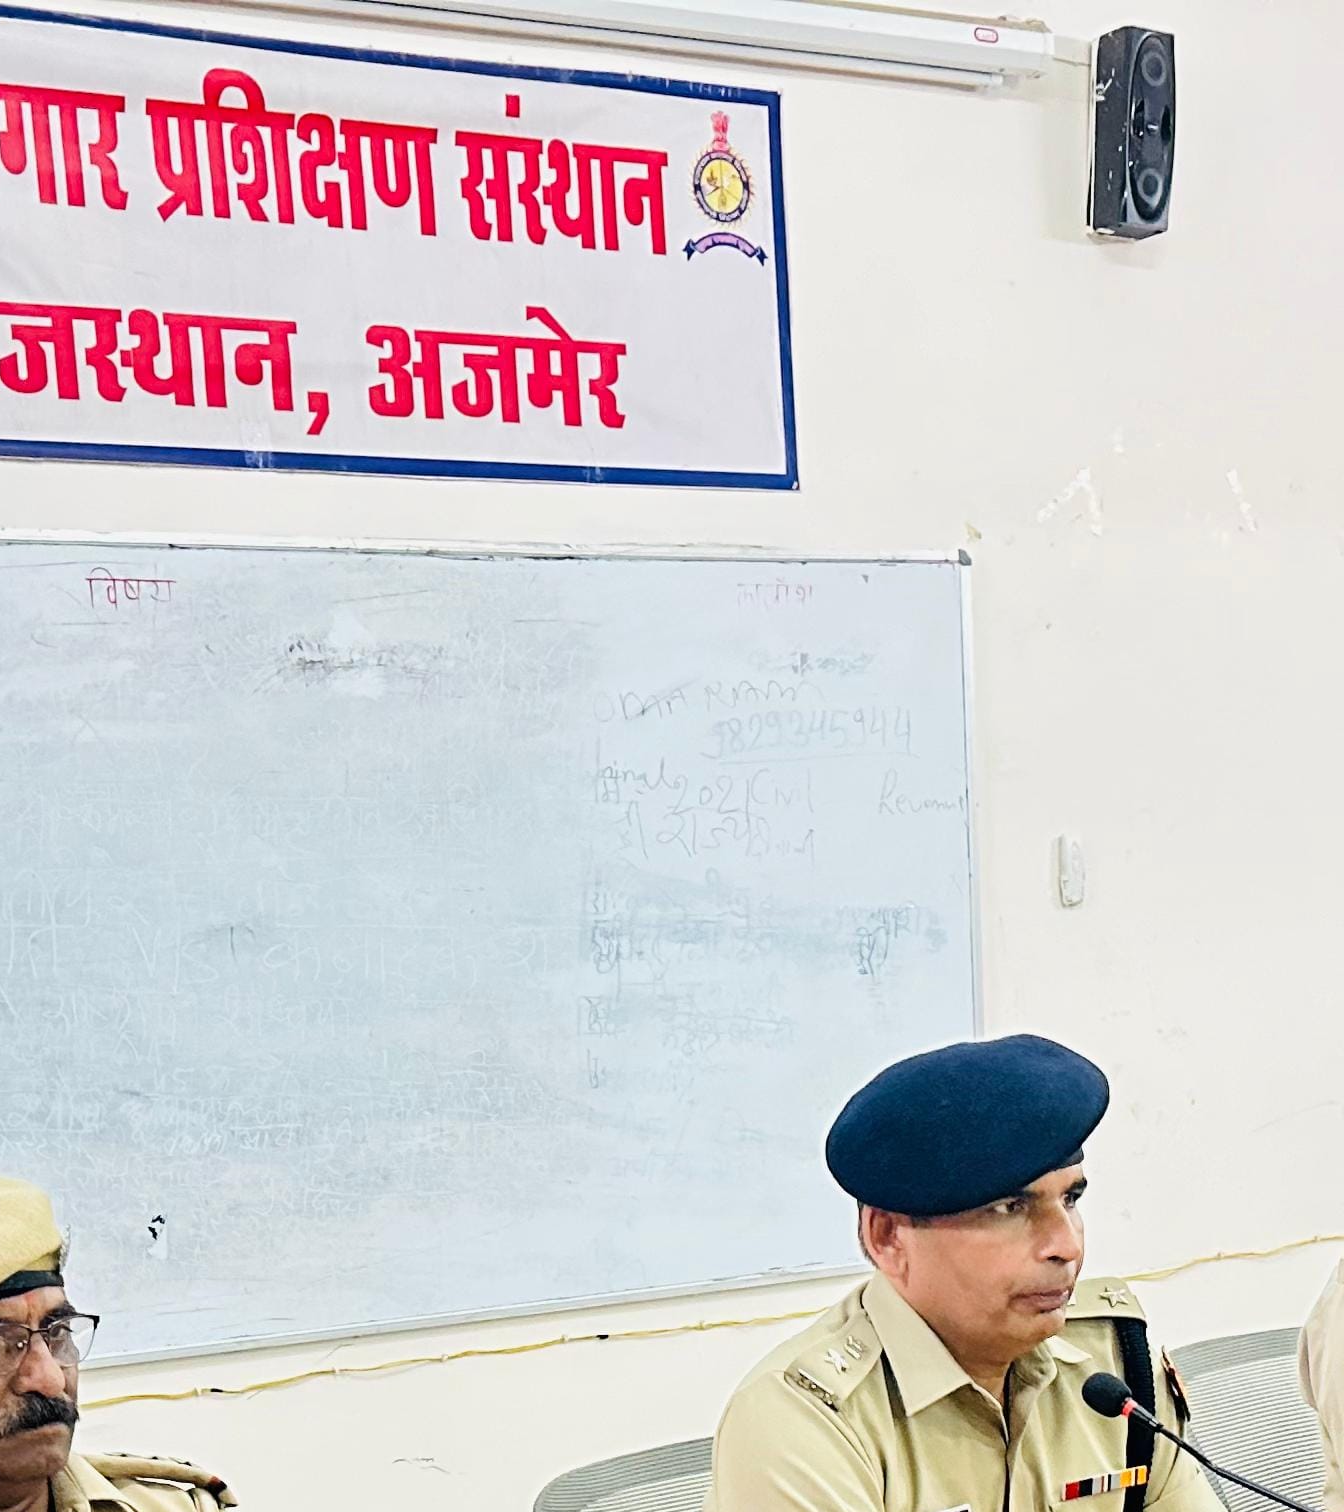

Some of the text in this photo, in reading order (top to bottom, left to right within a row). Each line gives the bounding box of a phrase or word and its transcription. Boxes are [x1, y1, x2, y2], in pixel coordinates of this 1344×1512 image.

[146, 67, 438, 237] प्रशिक्षण
[455, 93, 668, 255] संस्थान
[366, 305, 628, 430] अजमेर
